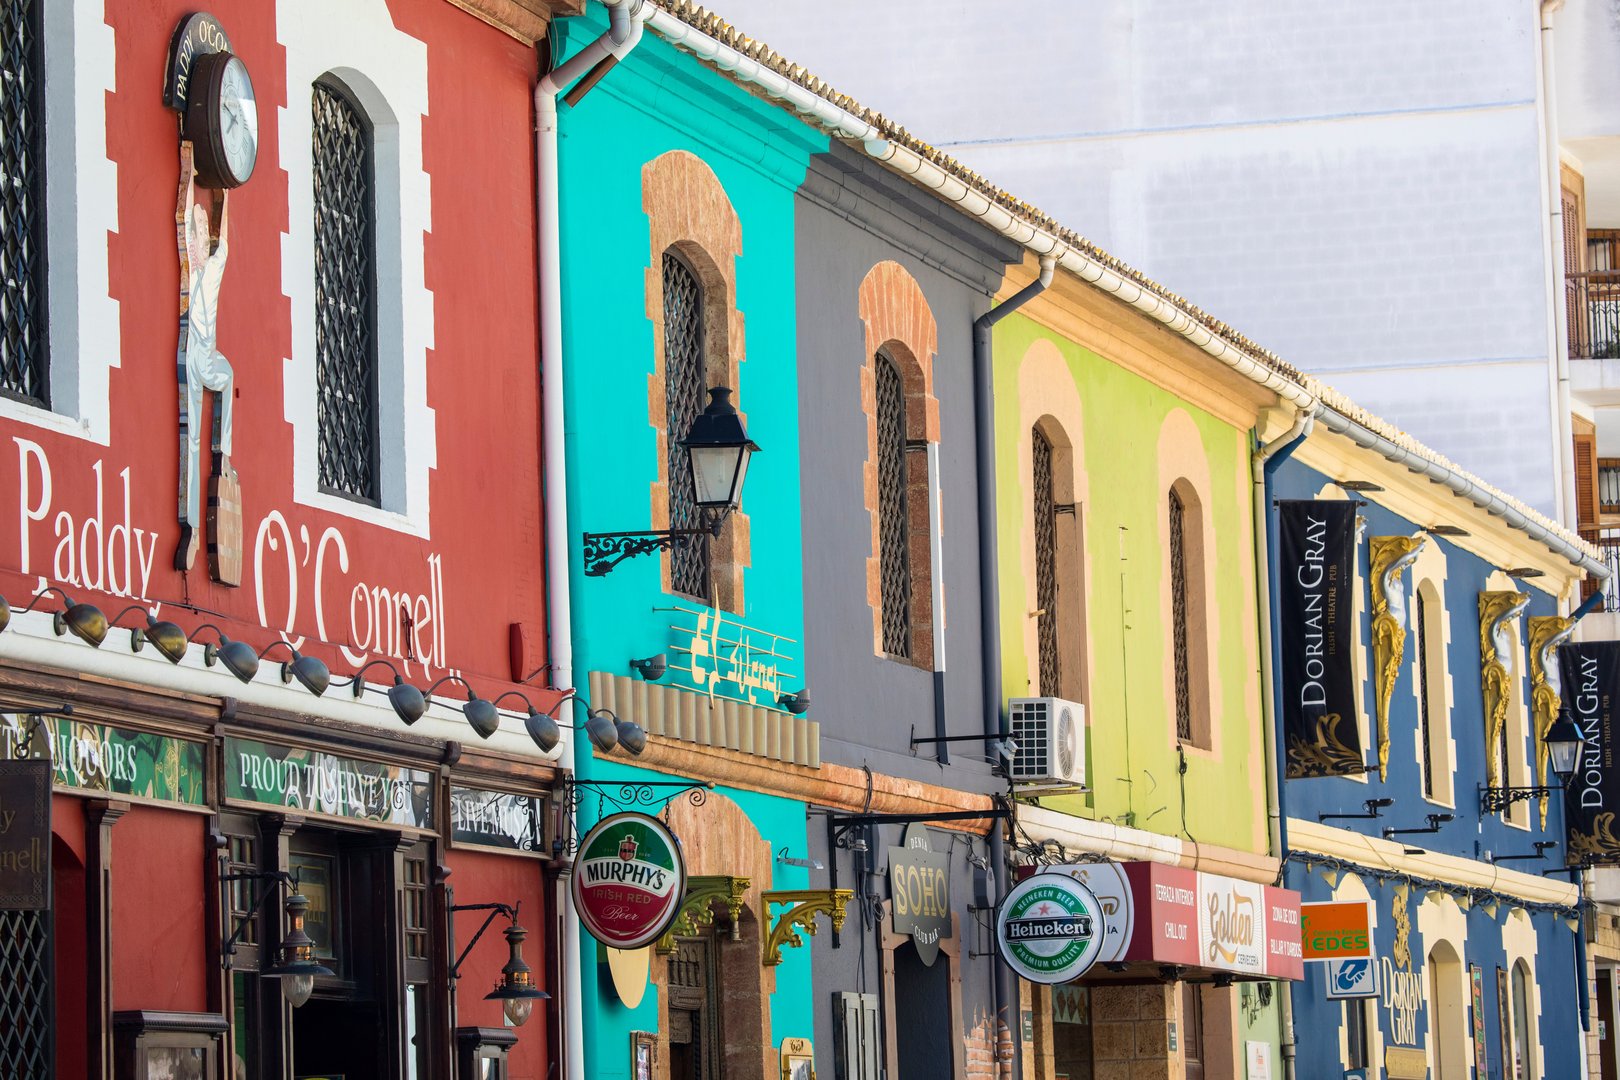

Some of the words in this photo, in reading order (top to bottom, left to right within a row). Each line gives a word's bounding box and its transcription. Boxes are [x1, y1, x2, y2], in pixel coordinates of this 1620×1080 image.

[176, 29, 196, 101] PADDY
[12, 436, 161, 619] Paddy
[254, 509, 463, 686] O'Connell
[1297, 515, 1327, 591] GRAY
[1329, 564, 1337, 580] PUB
[1328, 586, 1337, 624] THEATRE
[1301, 592, 1327, 708] DORIAN
[1328, 631, 1336, 655] IRISH
[1577, 655, 1599, 714] GRAY
[49, 732, 137, 785] LIQUORS
[1581, 718, 1603, 808] DORIAN
[240, 752, 301, 796] PROUD
[304, 763, 325, 801] TO
[325, 767, 378, 809] SERVE
[381, 777, 414, 814] YOU
[456, 799, 490, 834] LIVE
[587, 861, 666, 890] MURPHY'S
[894, 863, 948, 919] SOHO
[593, 888, 623, 902] IRISH
[627, 893, 651, 905] RED
[601, 904, 641, 921] Beer
[1017, 889, 1054, 911] HEINEKEN
[1056, 889, 1075, 909] BEER
[1155, 884, 1175, 903] TERRAZA
[1175, 886, 1194, 907] INTERIOR
[1010, 920, 1085, 938] Heineken
[1164, 922, 1178, 939] CHILL
[1178, 924, 1187, 940] OUT
[1207, 883, 1255, 964] Golden
[1272, 906, 1283, 922] ZONA
[914, 925, 928, 945] CLUB
[929, 928, 939, 945] BAR
[1270, 938, 1284, 955] BILLAR
[1016, 946, 1050, 968] PREMIUM
[1052, 944, 1081, 967] QUALITY
[1381, 956, 1423, 1011] DORIAN
[1389, 1003, 1417, 1046] GRAY
